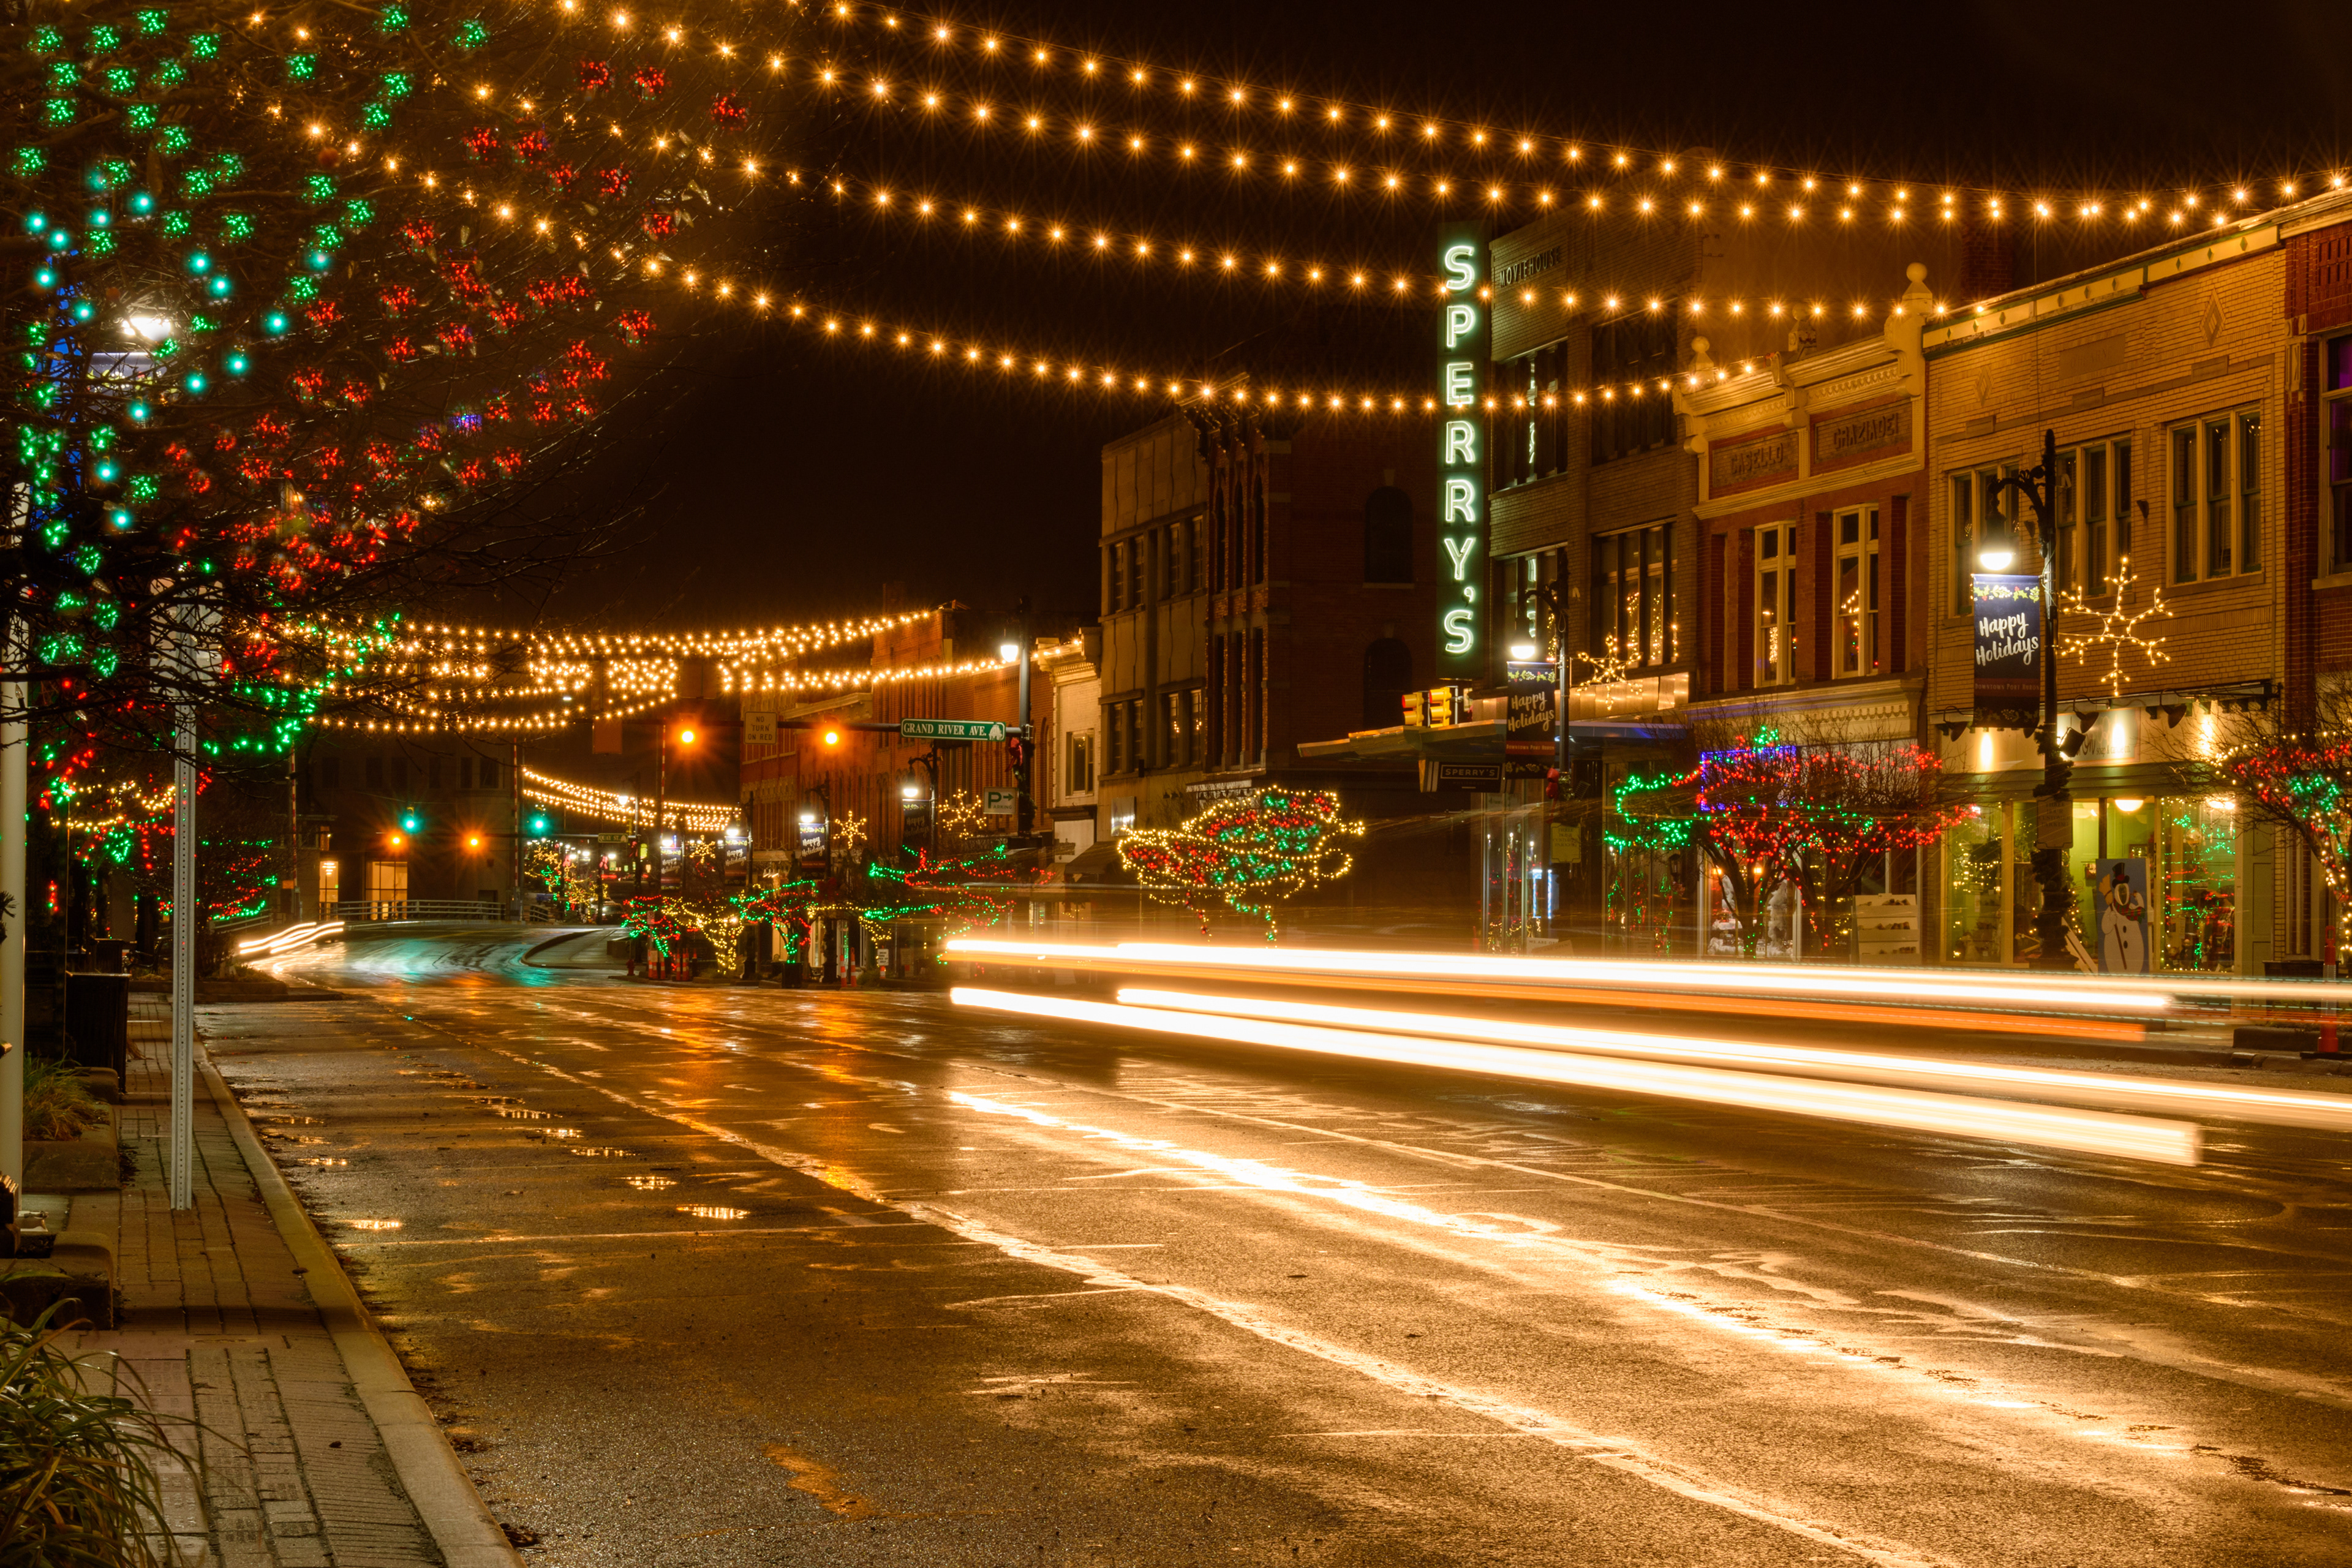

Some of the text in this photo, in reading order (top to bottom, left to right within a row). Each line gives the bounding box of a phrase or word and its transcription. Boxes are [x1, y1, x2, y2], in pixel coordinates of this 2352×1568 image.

[1499, 246, 1561, 288] MOVIEHOUSE
[1443, 245, 1477, 654] SPERRY'S
[1731, 442, 1784, 475] CASELLO
[1979, 612, 2030, 639] Happy
[1975, 636, 2040, 667] Holidays
[1511, 691, 1548, 712] Happy
[903, 722, 987, 737] GRAND RIVER AVE.
[1507, 709, 1555, 732] Holidays
[1445, 768, 1496, 777] SPERRY'S
[801, 845, 826, 858] Holidays
[802, 837, 821, 846] Happy
